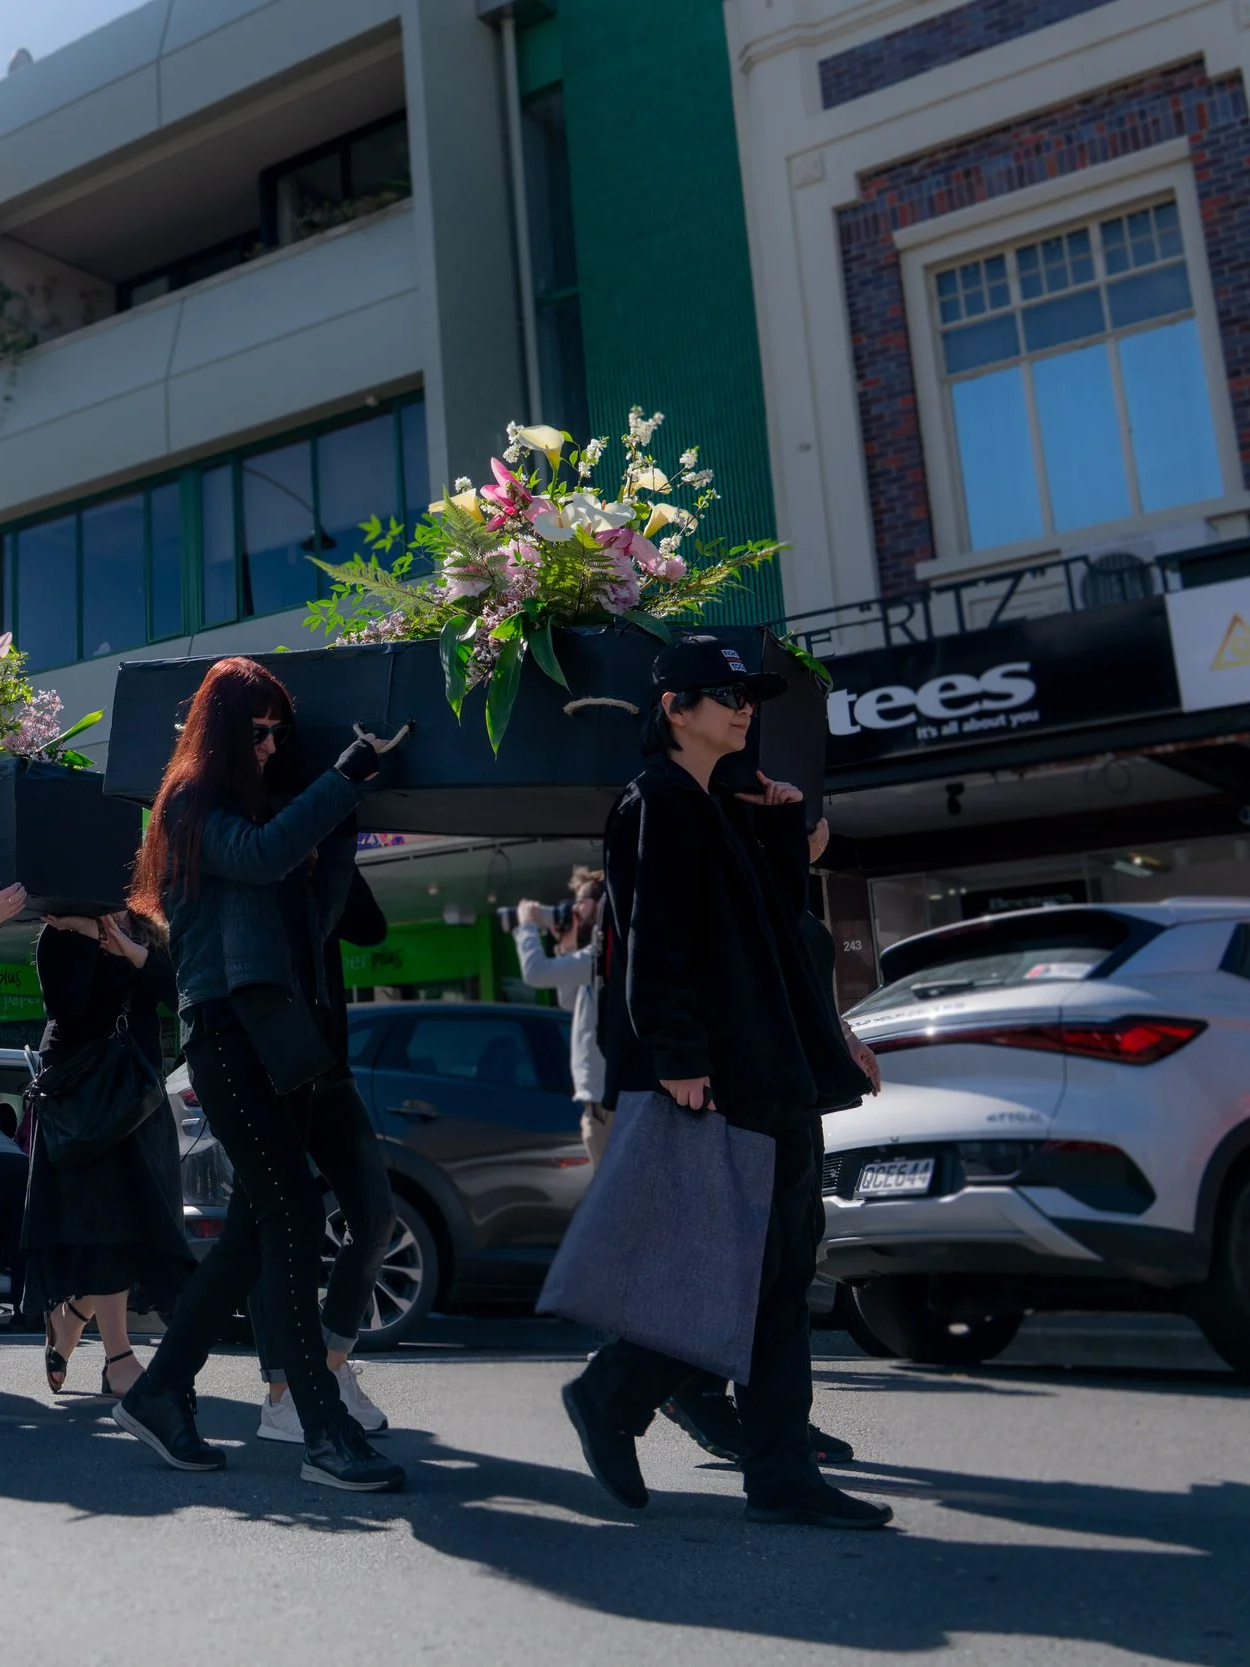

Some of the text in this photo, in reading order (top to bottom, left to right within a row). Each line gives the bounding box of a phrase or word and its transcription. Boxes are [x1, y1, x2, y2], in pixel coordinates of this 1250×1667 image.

[827, 662, 1036, 736] tees
[962, 713, 1008, 733] about
[843, 940, 862, 952] 243
[862, 1161, 931, 1189] QCE644
